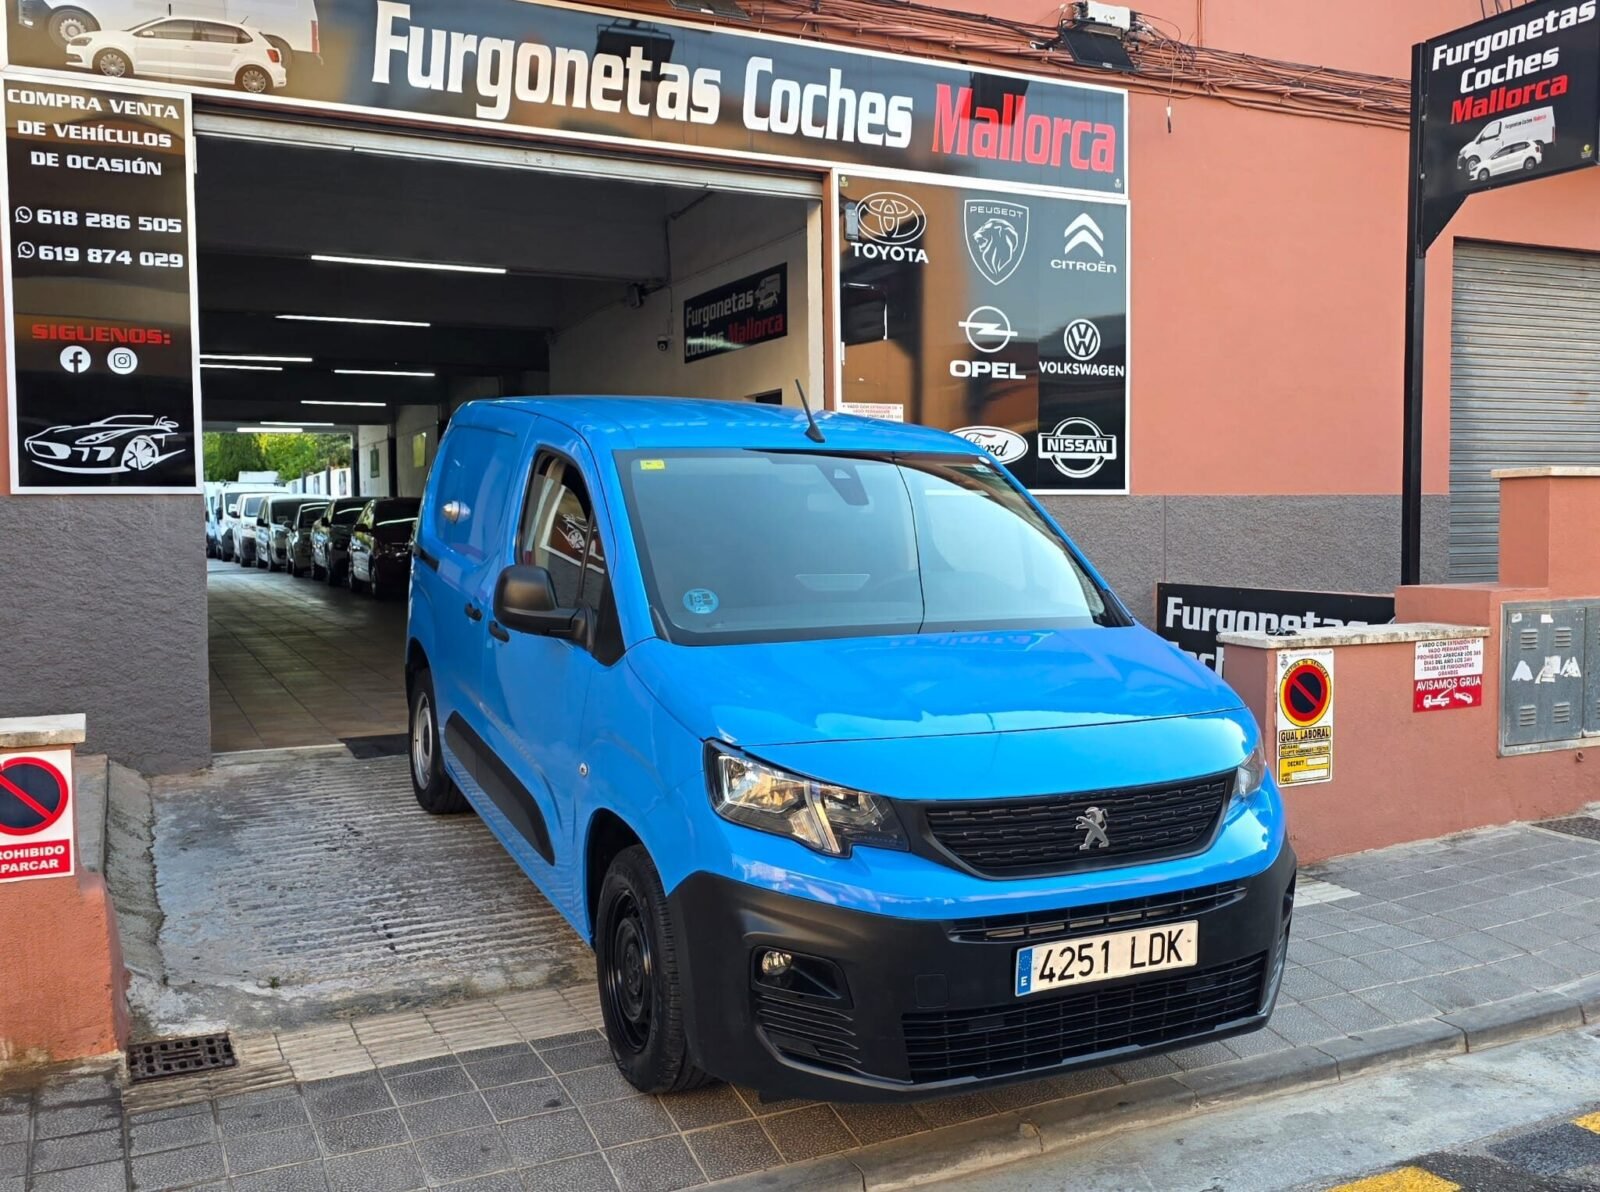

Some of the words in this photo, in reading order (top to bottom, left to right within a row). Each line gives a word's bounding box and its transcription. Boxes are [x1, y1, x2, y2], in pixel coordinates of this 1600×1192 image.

[1432, 0, 1597, 71] Furgonetas
[1460, 47, 1560, 94] Coches
[372, 0, 721, 125] Furgonetas
[743, 56, 914, 148] Coches
[932, 83, 1117, 173] Mallorca
[7, 88, 102, 111] COMPRA
[109, 99, 179, 119] VENTA
[1451, 74, 1568, 125] Mallorca
[17, 120, 46, 136] DE
[54, 123, 172, 148] VEHÍCULOS
[30, 151, 59, 168] DE
[66, 154, 162, 176] OCASIÓN
[36, 209, 78, 226] 618
[86, 212, 131, 230] 286
[138, 216, 182, 233] 505
[970, 205, 1023, 218] PEUGEOT
[39, 245, 79, 262] 619
[87, 248, 132, 265] 874
[139, 251, 183, 268] 029
[851, 242, 929, 264] TOYOTA
[686, 290, 754, 328] Furgonetas
[32, 324, 171, 345] SIGUENOS:
[728, 313, 784, 344] Mallorca
[949, 359, 1026, 380] OPEL
[1038, 361, 1125, 377] VOLKSWAGEN
[964, 432, 1009, 457] Frd
[1047, 438, 1108, 453] NISSAN
[1165, 596, 1369, 633] Furgonet
[1416, 678, 1458, 691] AVISAMOS
[1459, 675, 1482, 687] GRUA
[1281, 731, 1298, 742] GUAL
[1300, 728, 1329, 740] LABORAL
[0, 858, 59, 873] PARCAR
[1020, 976, 1028, 986] E
[1039, 940, 1110, 982] 4251
[1130, 929, 1184, 969] LDK
